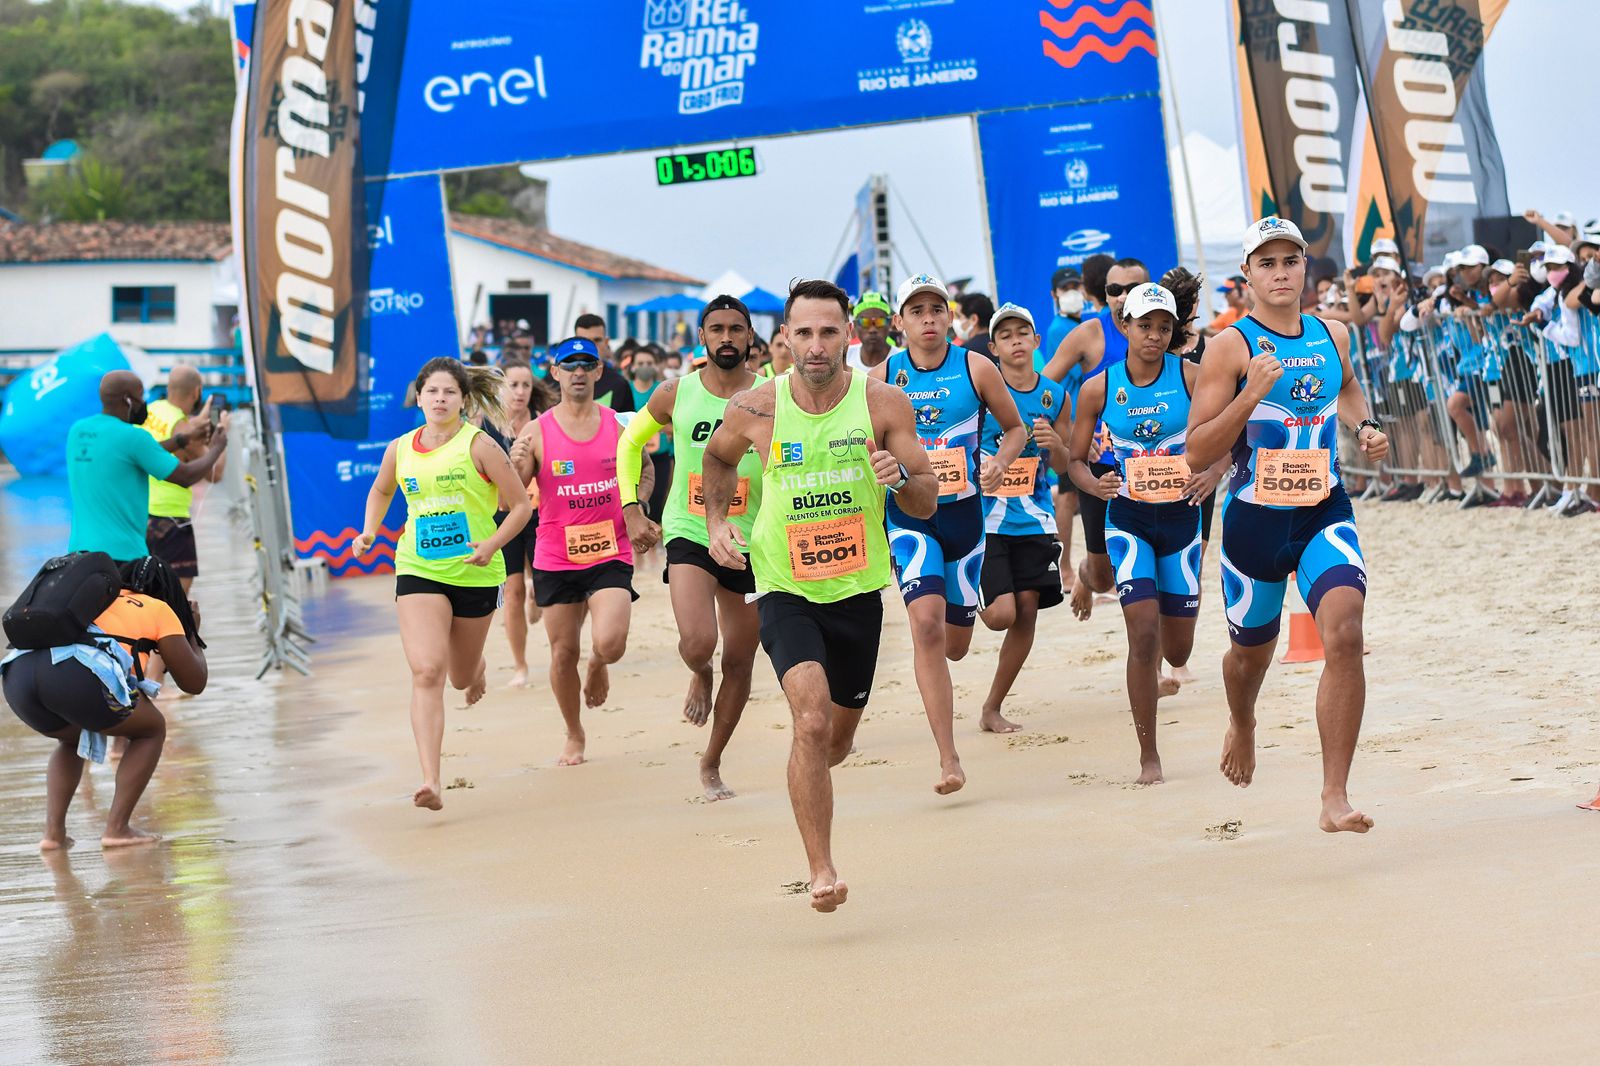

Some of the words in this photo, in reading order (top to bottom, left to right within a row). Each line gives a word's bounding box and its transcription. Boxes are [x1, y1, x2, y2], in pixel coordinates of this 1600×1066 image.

[641, 22, 758, 68] Rainha
[681, 52, 756, 89] mar
[424, 55, 547, 112] enel
[859, 77, 887, 92] RIO
[889, 75, 910, 88] DE
[913, 67, 978, 86] JANEIRO
[1040, 197, 1059, 207] RIO
[1060, 195, 1073, 206] DE
[1076, 190, 1119, 204] JANEIRO
[1283, 415, 1325, 428] CALOI
[919, 437, 949, 446] ALOI
[773, 444, 802, 463] LFS
[780, 466, 864, 492] ATLETISMO
[938, 471, 960, 482] 43
[1003, 476, 1029, 487] 044
[1263, 477, 1322, 491] 5046
[556, 477, 618, 497] ATLETISMO
[1134, 478, 1185, 492] 5045
[569, 493, 612, 509] BÚZIOS
[694, 494, 742, 506] 55
[793, 490, 853, 511] BÚZIOS
[786, 511, 819, 522] TALENTOS
[821, 509, 832, 517] EM
[833, 505, 863, 515] CORRIDA
[420, 533, 465, 549] 6020
[814, 532, 845, 541] Beach
[568, 540, 612, 555] 5002
[801, 544, 857, 566] 5001
